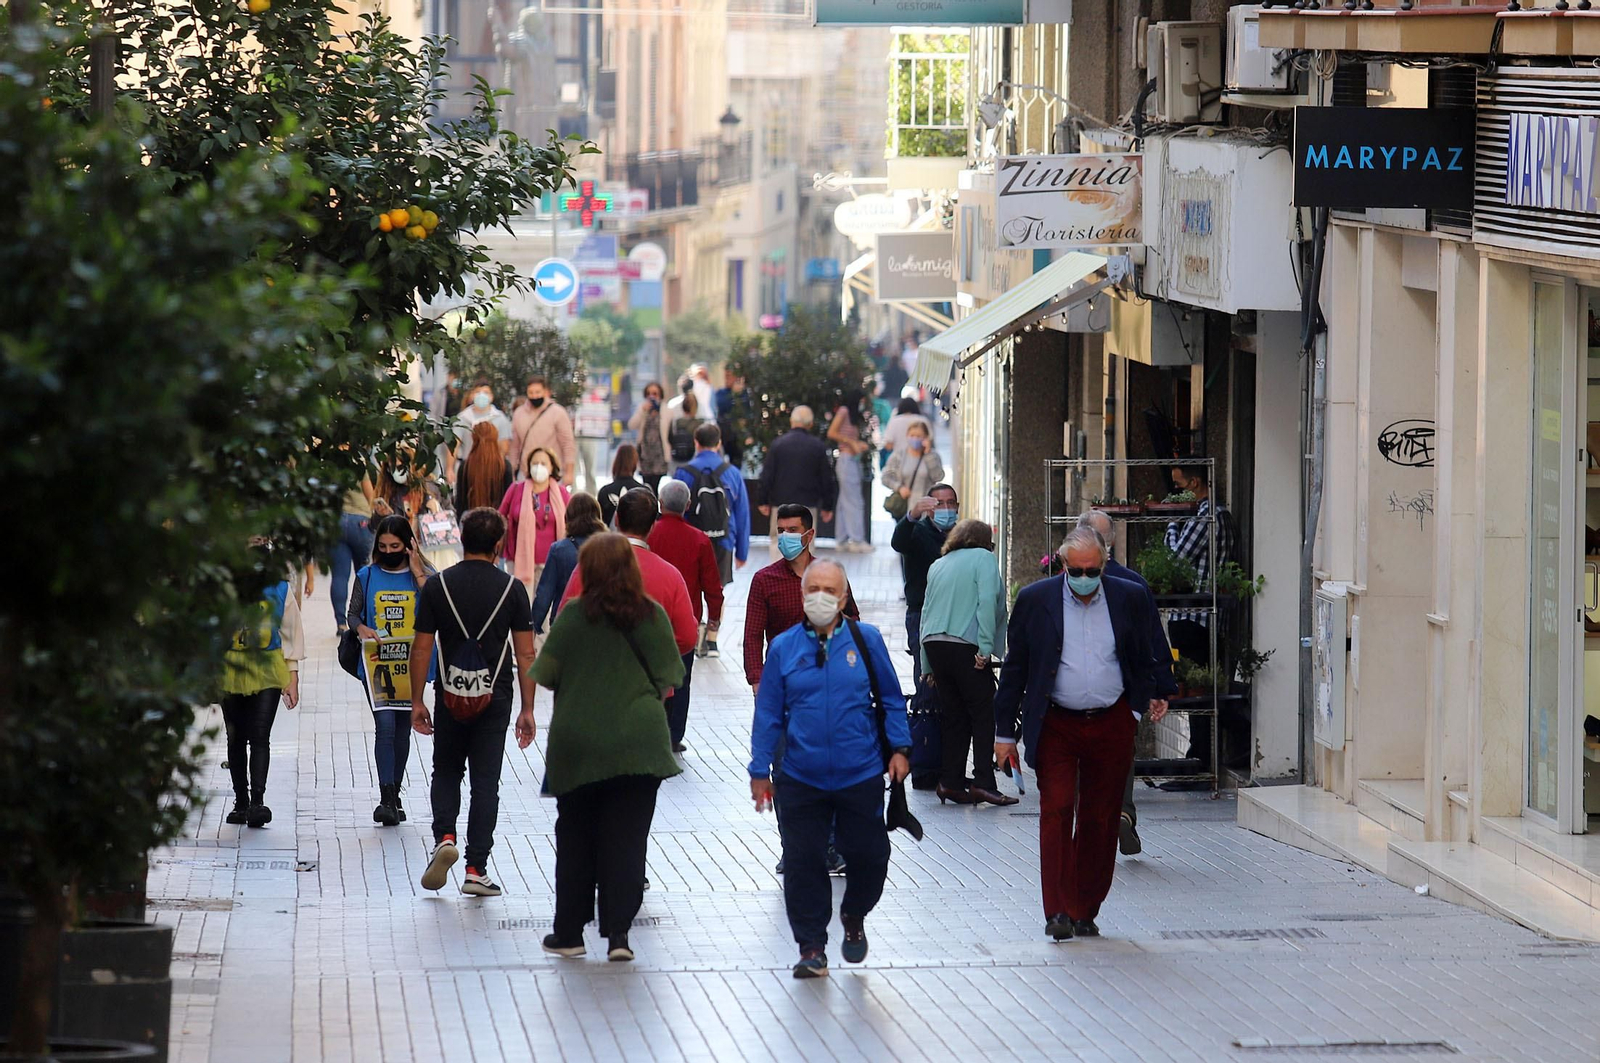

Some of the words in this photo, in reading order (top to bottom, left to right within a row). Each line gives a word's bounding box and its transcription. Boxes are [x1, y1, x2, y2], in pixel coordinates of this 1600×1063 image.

[896, 3, 943, 11] GESTORÍA
[1305, 144, 1463, 171] MARYPAZ
[1505, 113, 1599, 213] MARYPAZ
[999, 159, 1140, 196] Zinnia
[1002, 216, 1139, 246] Floristería
[380, 643, 407, 654] PIZZA
